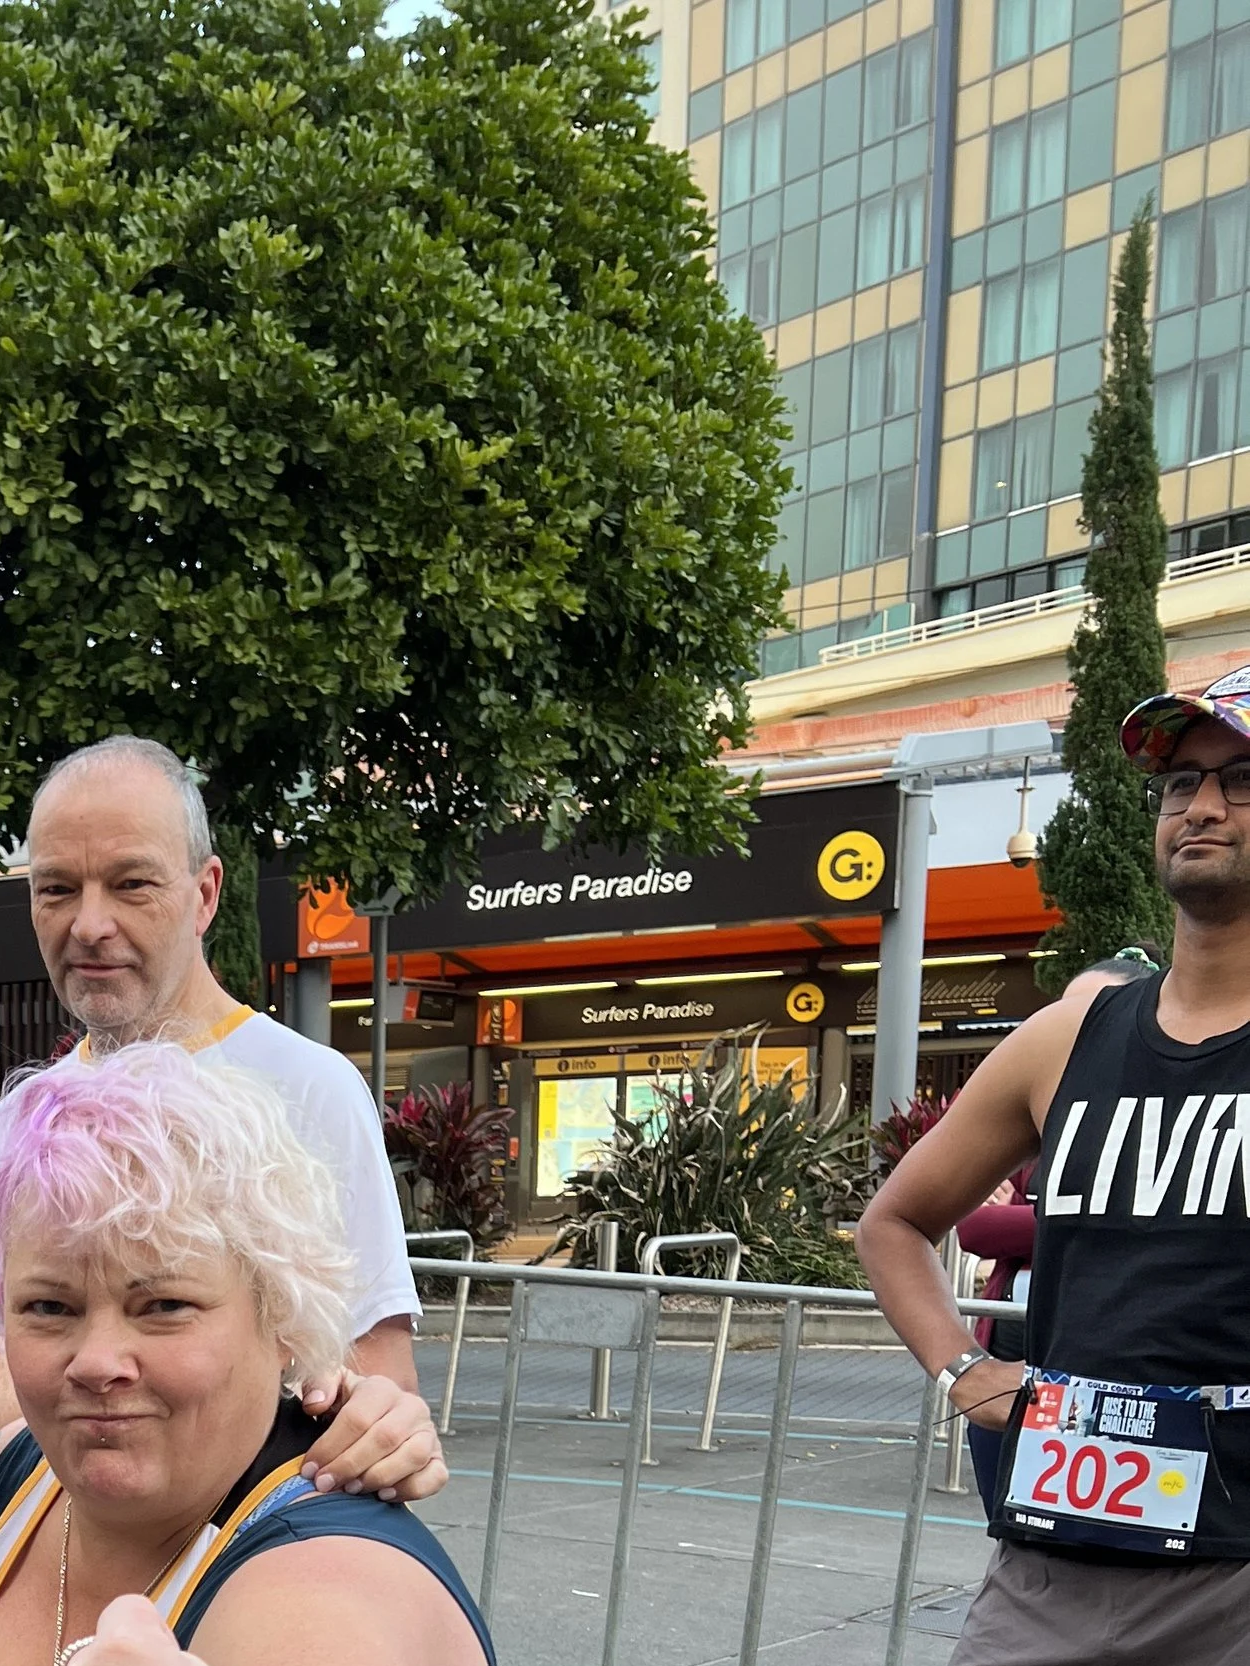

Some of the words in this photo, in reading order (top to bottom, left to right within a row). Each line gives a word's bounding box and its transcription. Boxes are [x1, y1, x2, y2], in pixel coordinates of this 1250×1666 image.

[466, 879, 562, 911] Surfers
[569, 868, 693, 901] Paradise
[581, 1004, 639, 1024] Surfers
[642, 1000, 715, 1020] Paradise
[571, 1059, 597, 1071] info
[1087, 1381, 1108, 1390] GOLD
[1110, 1385, 1141, 1395] COAST
[1102, 1396, 1124, 1416] RISE
[1124, 1398, 1137, 1418] TO
[1138, 1400, 1158, 1420] THE
[1099, 1415, 1156, 1438] CHALLENGE!
[1031, 1439, 1150, 1518] 202
[1165, 1538, 1186, 1550] 202
